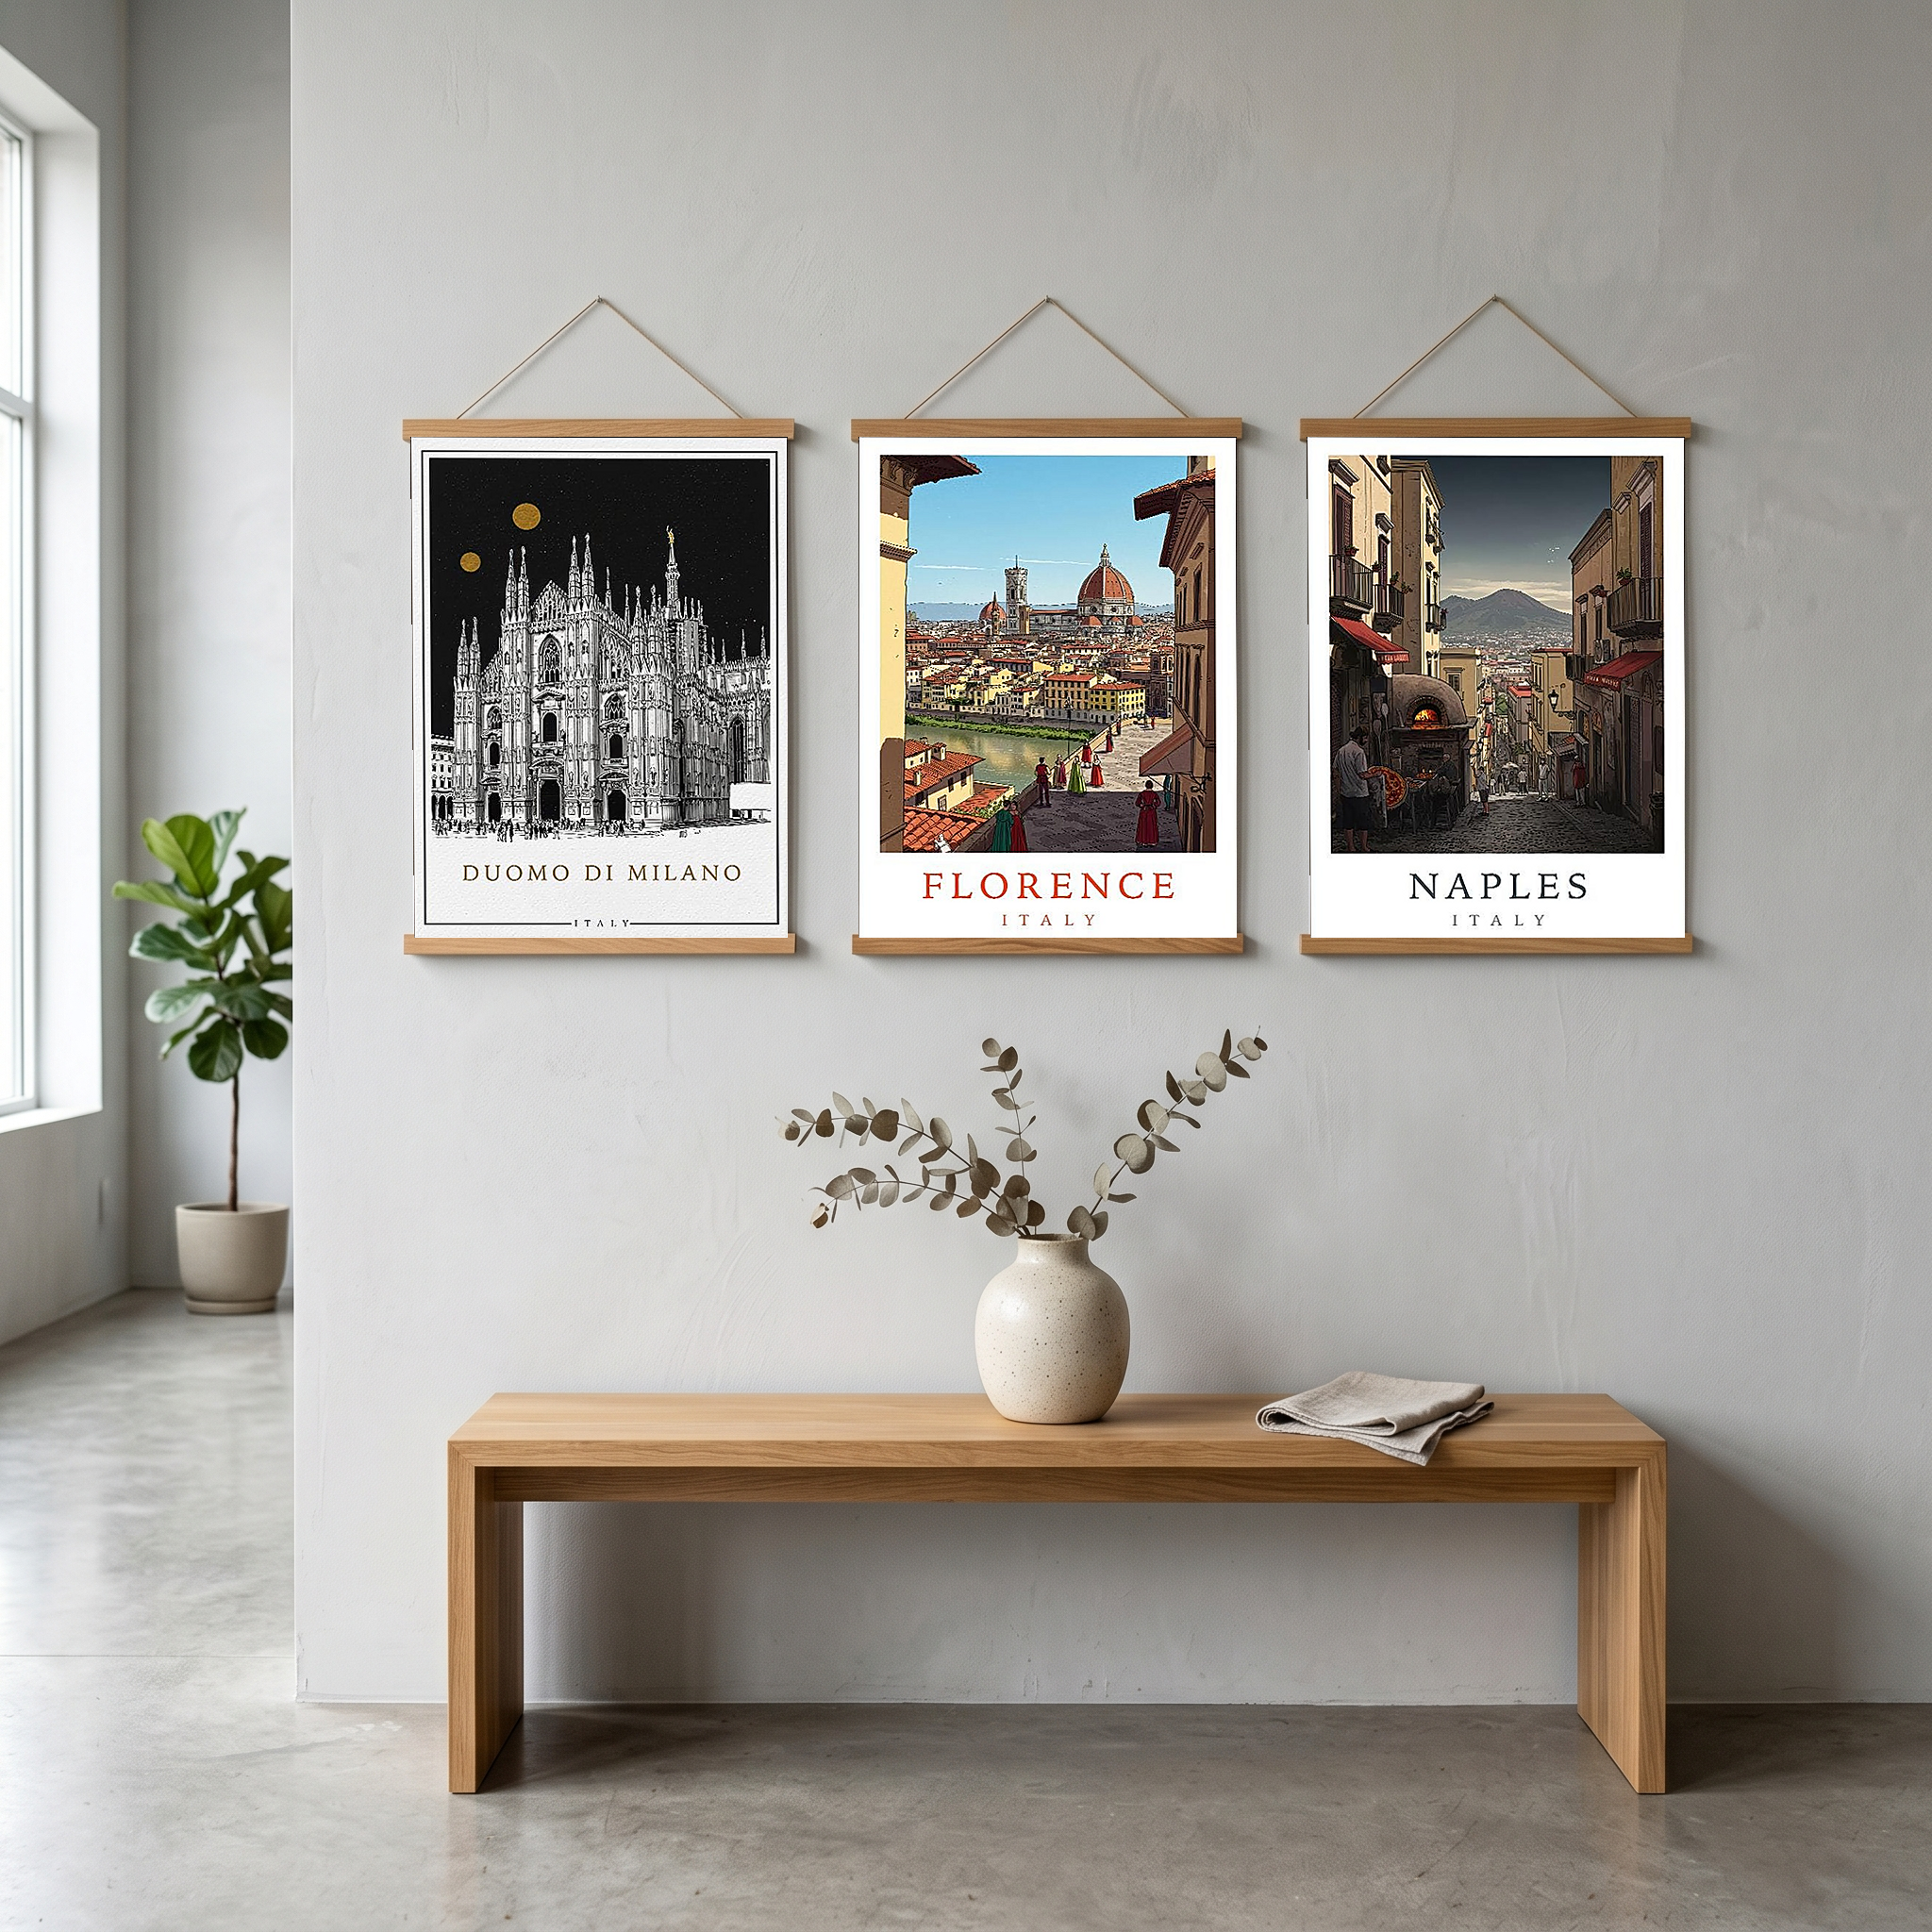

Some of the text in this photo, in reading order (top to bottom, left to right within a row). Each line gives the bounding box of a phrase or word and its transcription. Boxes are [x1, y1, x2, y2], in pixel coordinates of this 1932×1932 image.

[462, 864, 741, 882] DUOMO DI MILANO
[922, 872, 1174, 899] FLORENCE
[1408, 873, 1587, 899] NAPLES
[574, 919, 630, 927] ITALY
[1002, 914, 1095, 926] ITALY
[1452, 914, 1544, 926] ITALY
